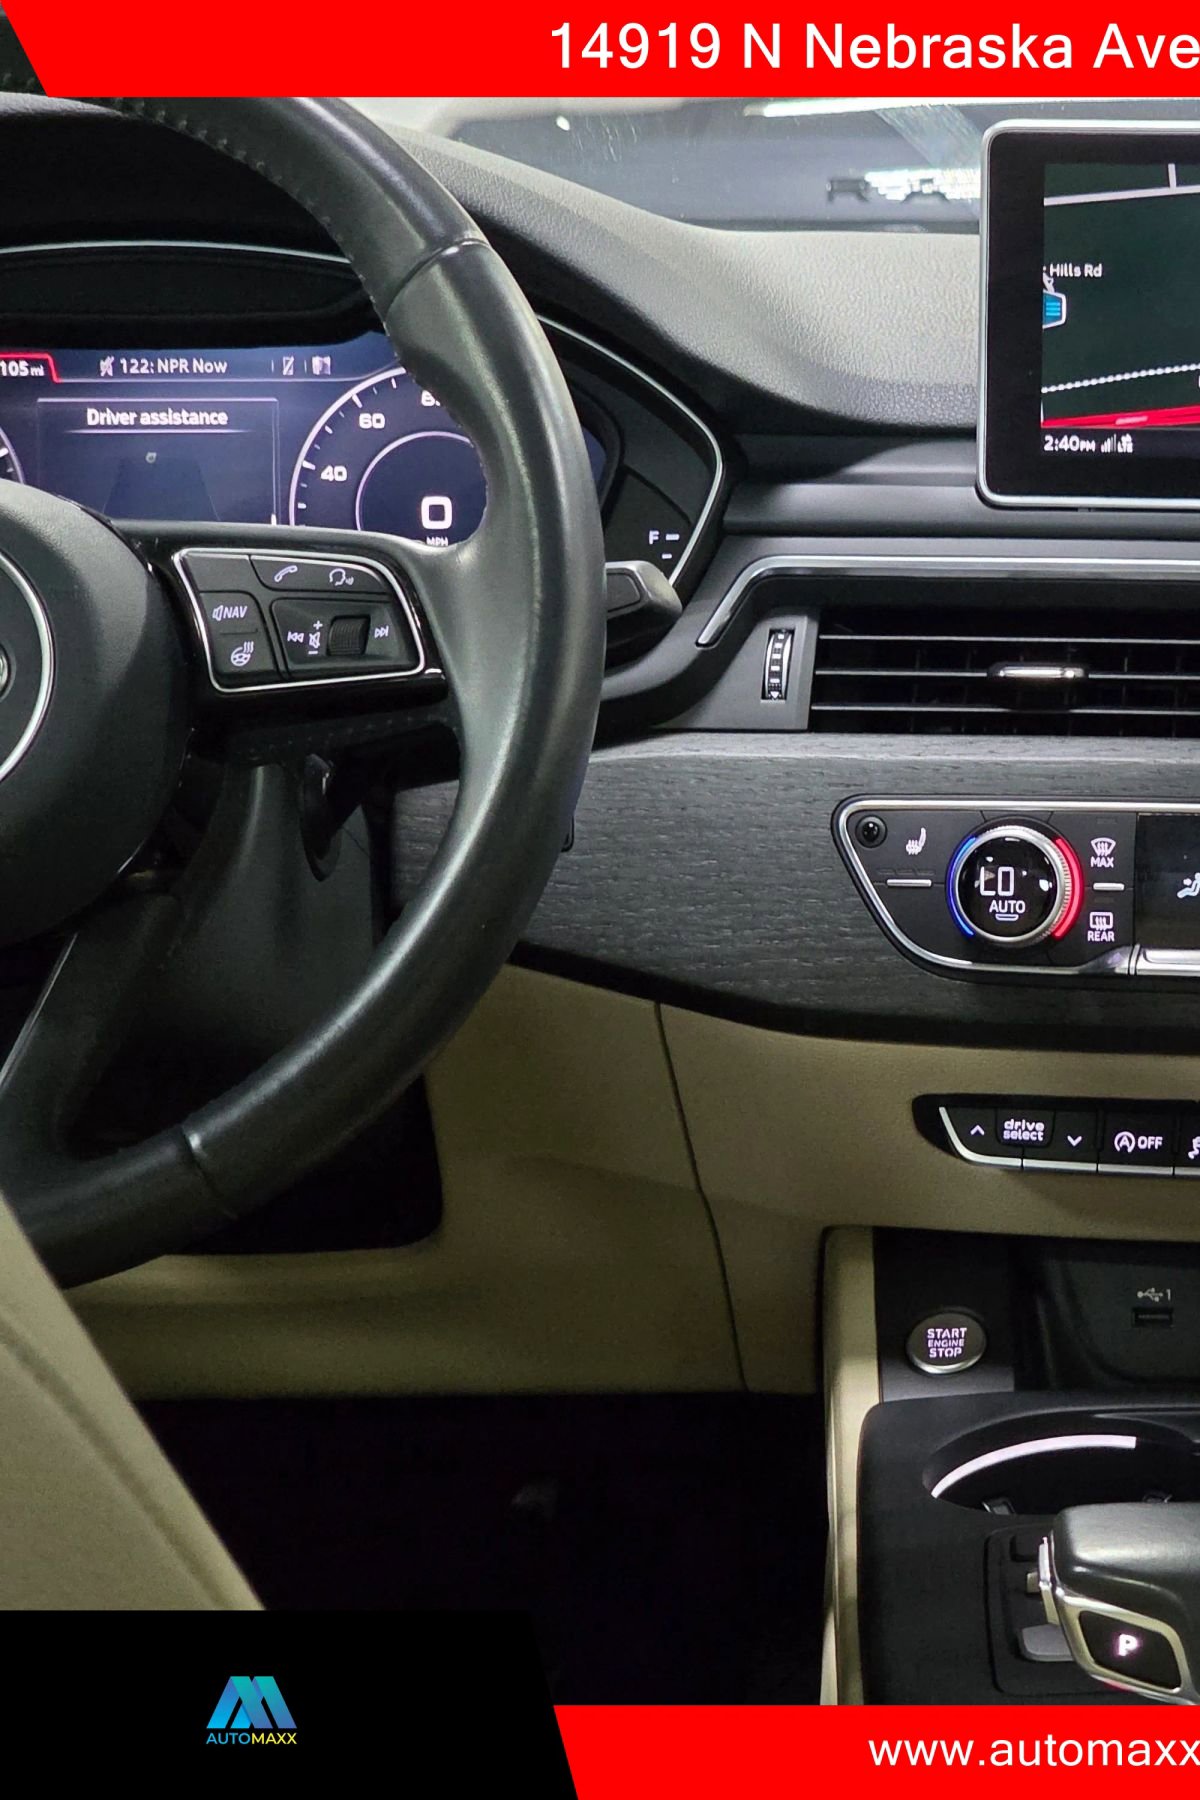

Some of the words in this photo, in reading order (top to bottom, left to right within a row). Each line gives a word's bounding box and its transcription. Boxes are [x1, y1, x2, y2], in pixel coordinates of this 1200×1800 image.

[1049, 263, 1081, 277] Hills
[1084, 263, 1103, 278] Rd
[120, 358, 155, 374] 122:
[157, 357, 190, 374] NPR
[192, 358, 228, 374] Now
[86, 407, 138, 426] Driver
[140, 407, 229, 426] assistance
[358, 413, 386, 429] 60
[320, 465, 348, 482] 40
[420, 495, 453, 530] 0
[648, 530, 660, 545] F
[223, 606, 248, 619] NAV
[1090, 856, 1115, 868] MAX
[988, 899, 1027, 914] AUTO
[1087, 930, 1116, 942] REAR
[1003, 1118, 1045, 1131] drive
[1002, 1130, 1044, 1142] select
[1137, 1135, 1163, 1150] OFF
[927, 1327, 968, 1339] START
[927, 1338, 965, 1348] ENGINE
[928, 1347, 963, 1359] STOP
[1117, 1633, 1140, 1657] P
